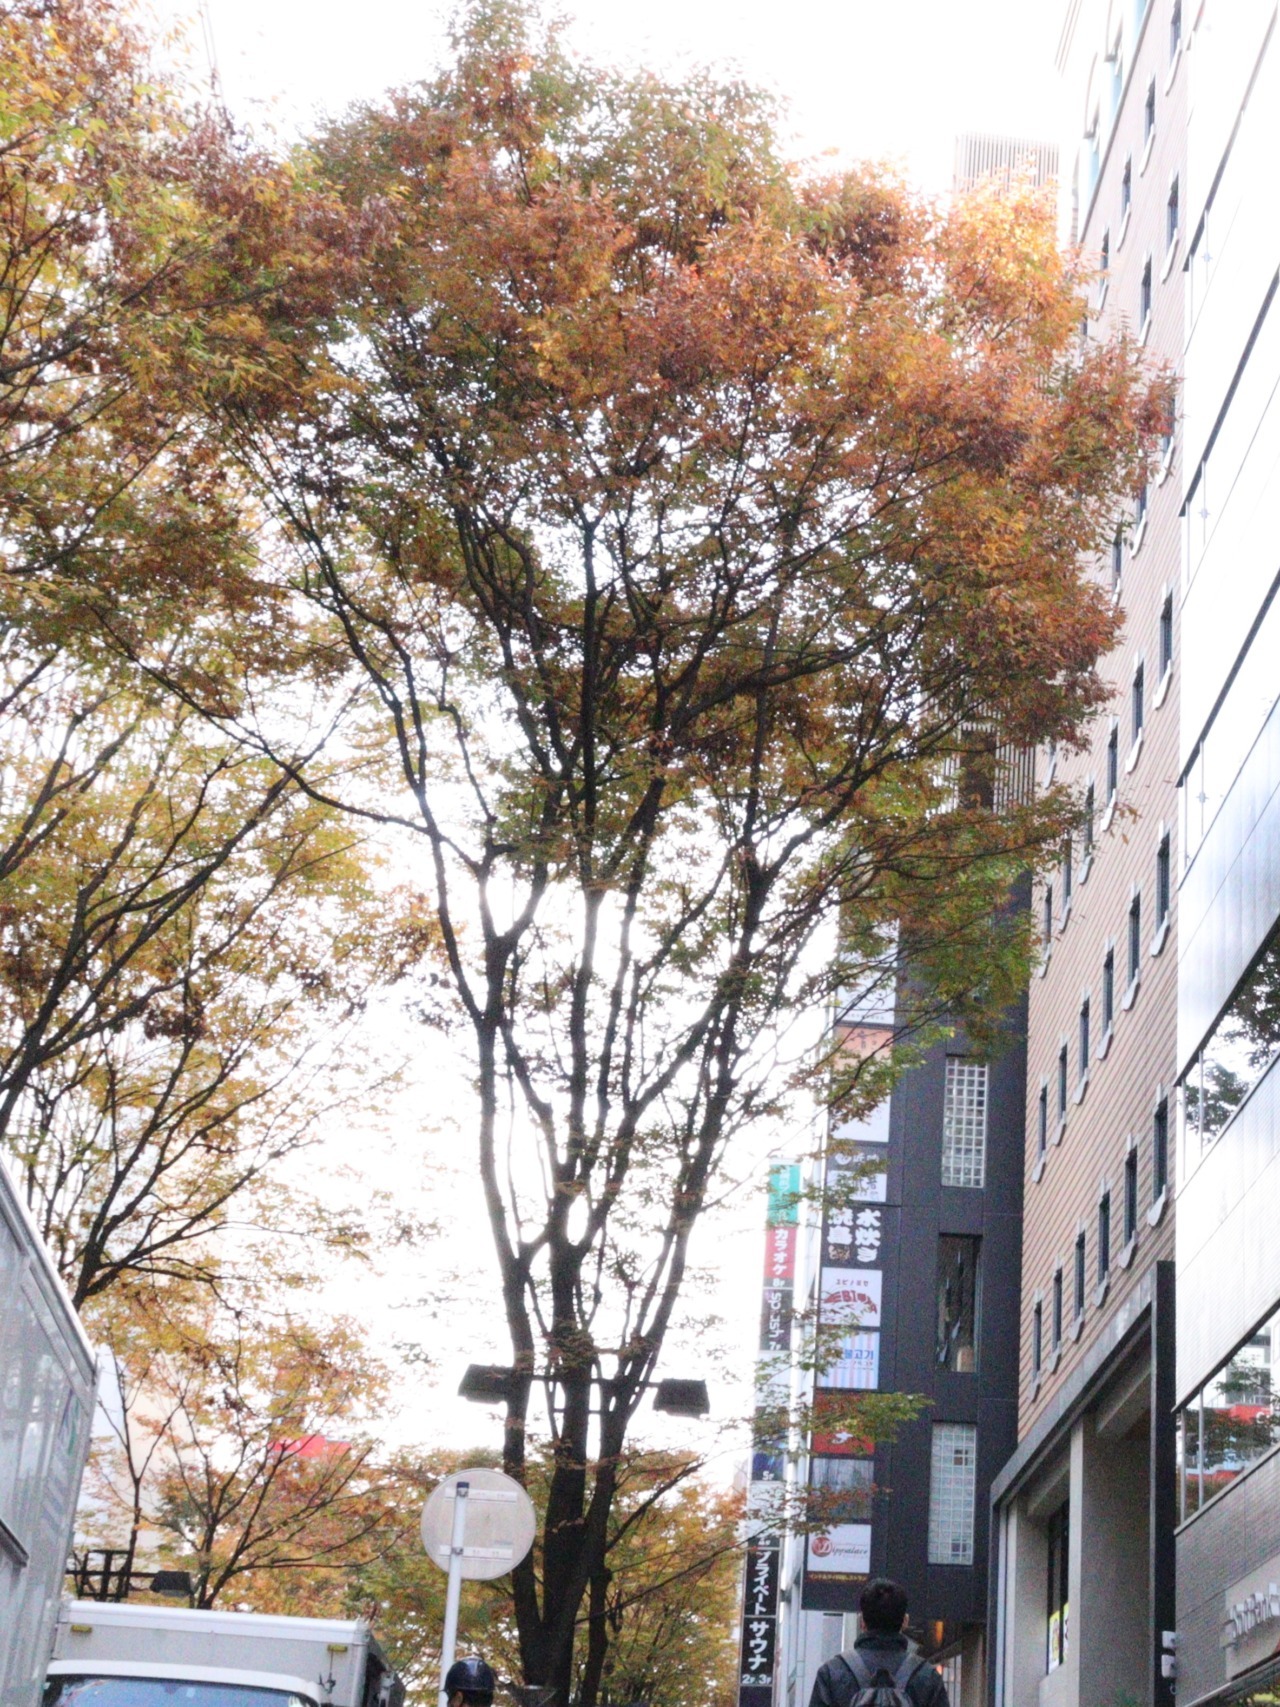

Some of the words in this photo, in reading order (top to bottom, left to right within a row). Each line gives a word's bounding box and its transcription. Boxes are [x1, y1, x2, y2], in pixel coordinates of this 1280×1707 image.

[773, 1229, 788, 1275] カラオケ
[752, 1551, 772, 1615] プライベート
[748, 1621, 769, 1670] サウナ
